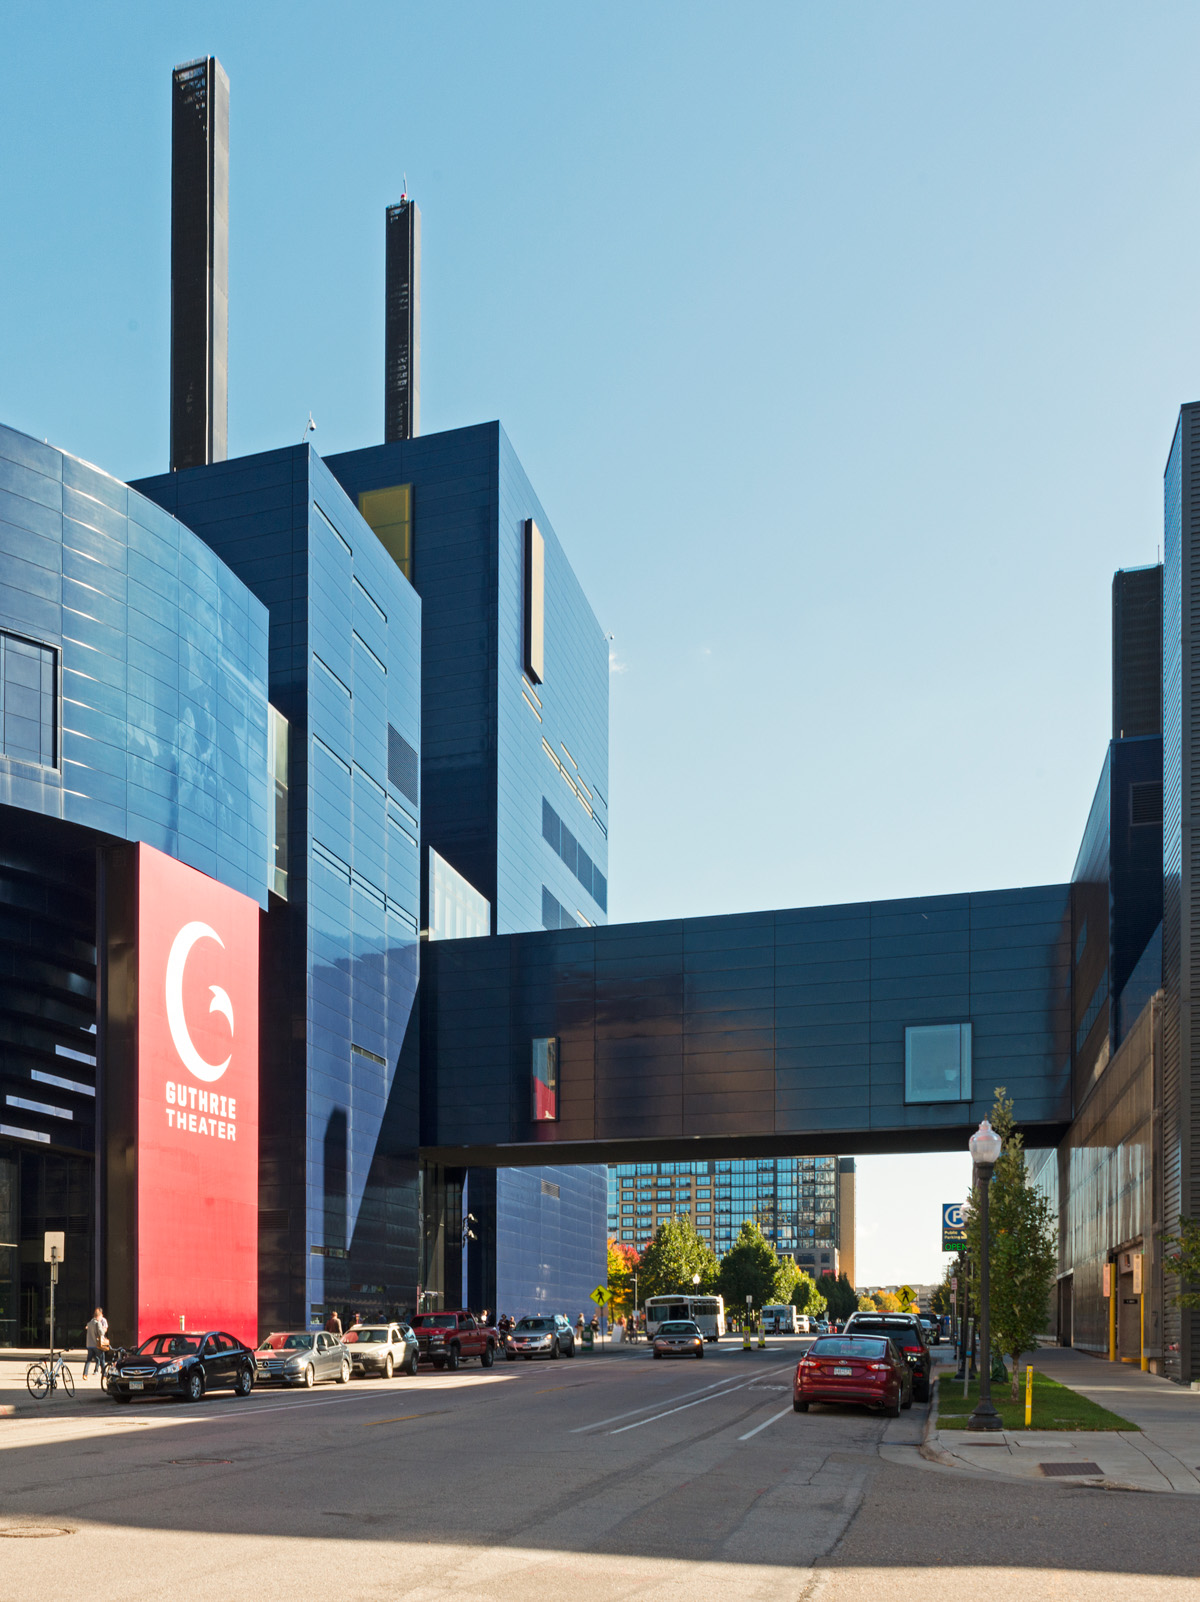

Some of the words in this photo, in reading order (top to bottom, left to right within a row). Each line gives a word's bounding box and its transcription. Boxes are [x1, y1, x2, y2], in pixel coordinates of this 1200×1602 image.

[165, 1080, 236, 1120] GUTHRIE
[165, 1108, 236, 1142] THEATER
[952, 1210, 962, 1223] P
[944, 1243, 968, 1251] OPEN
